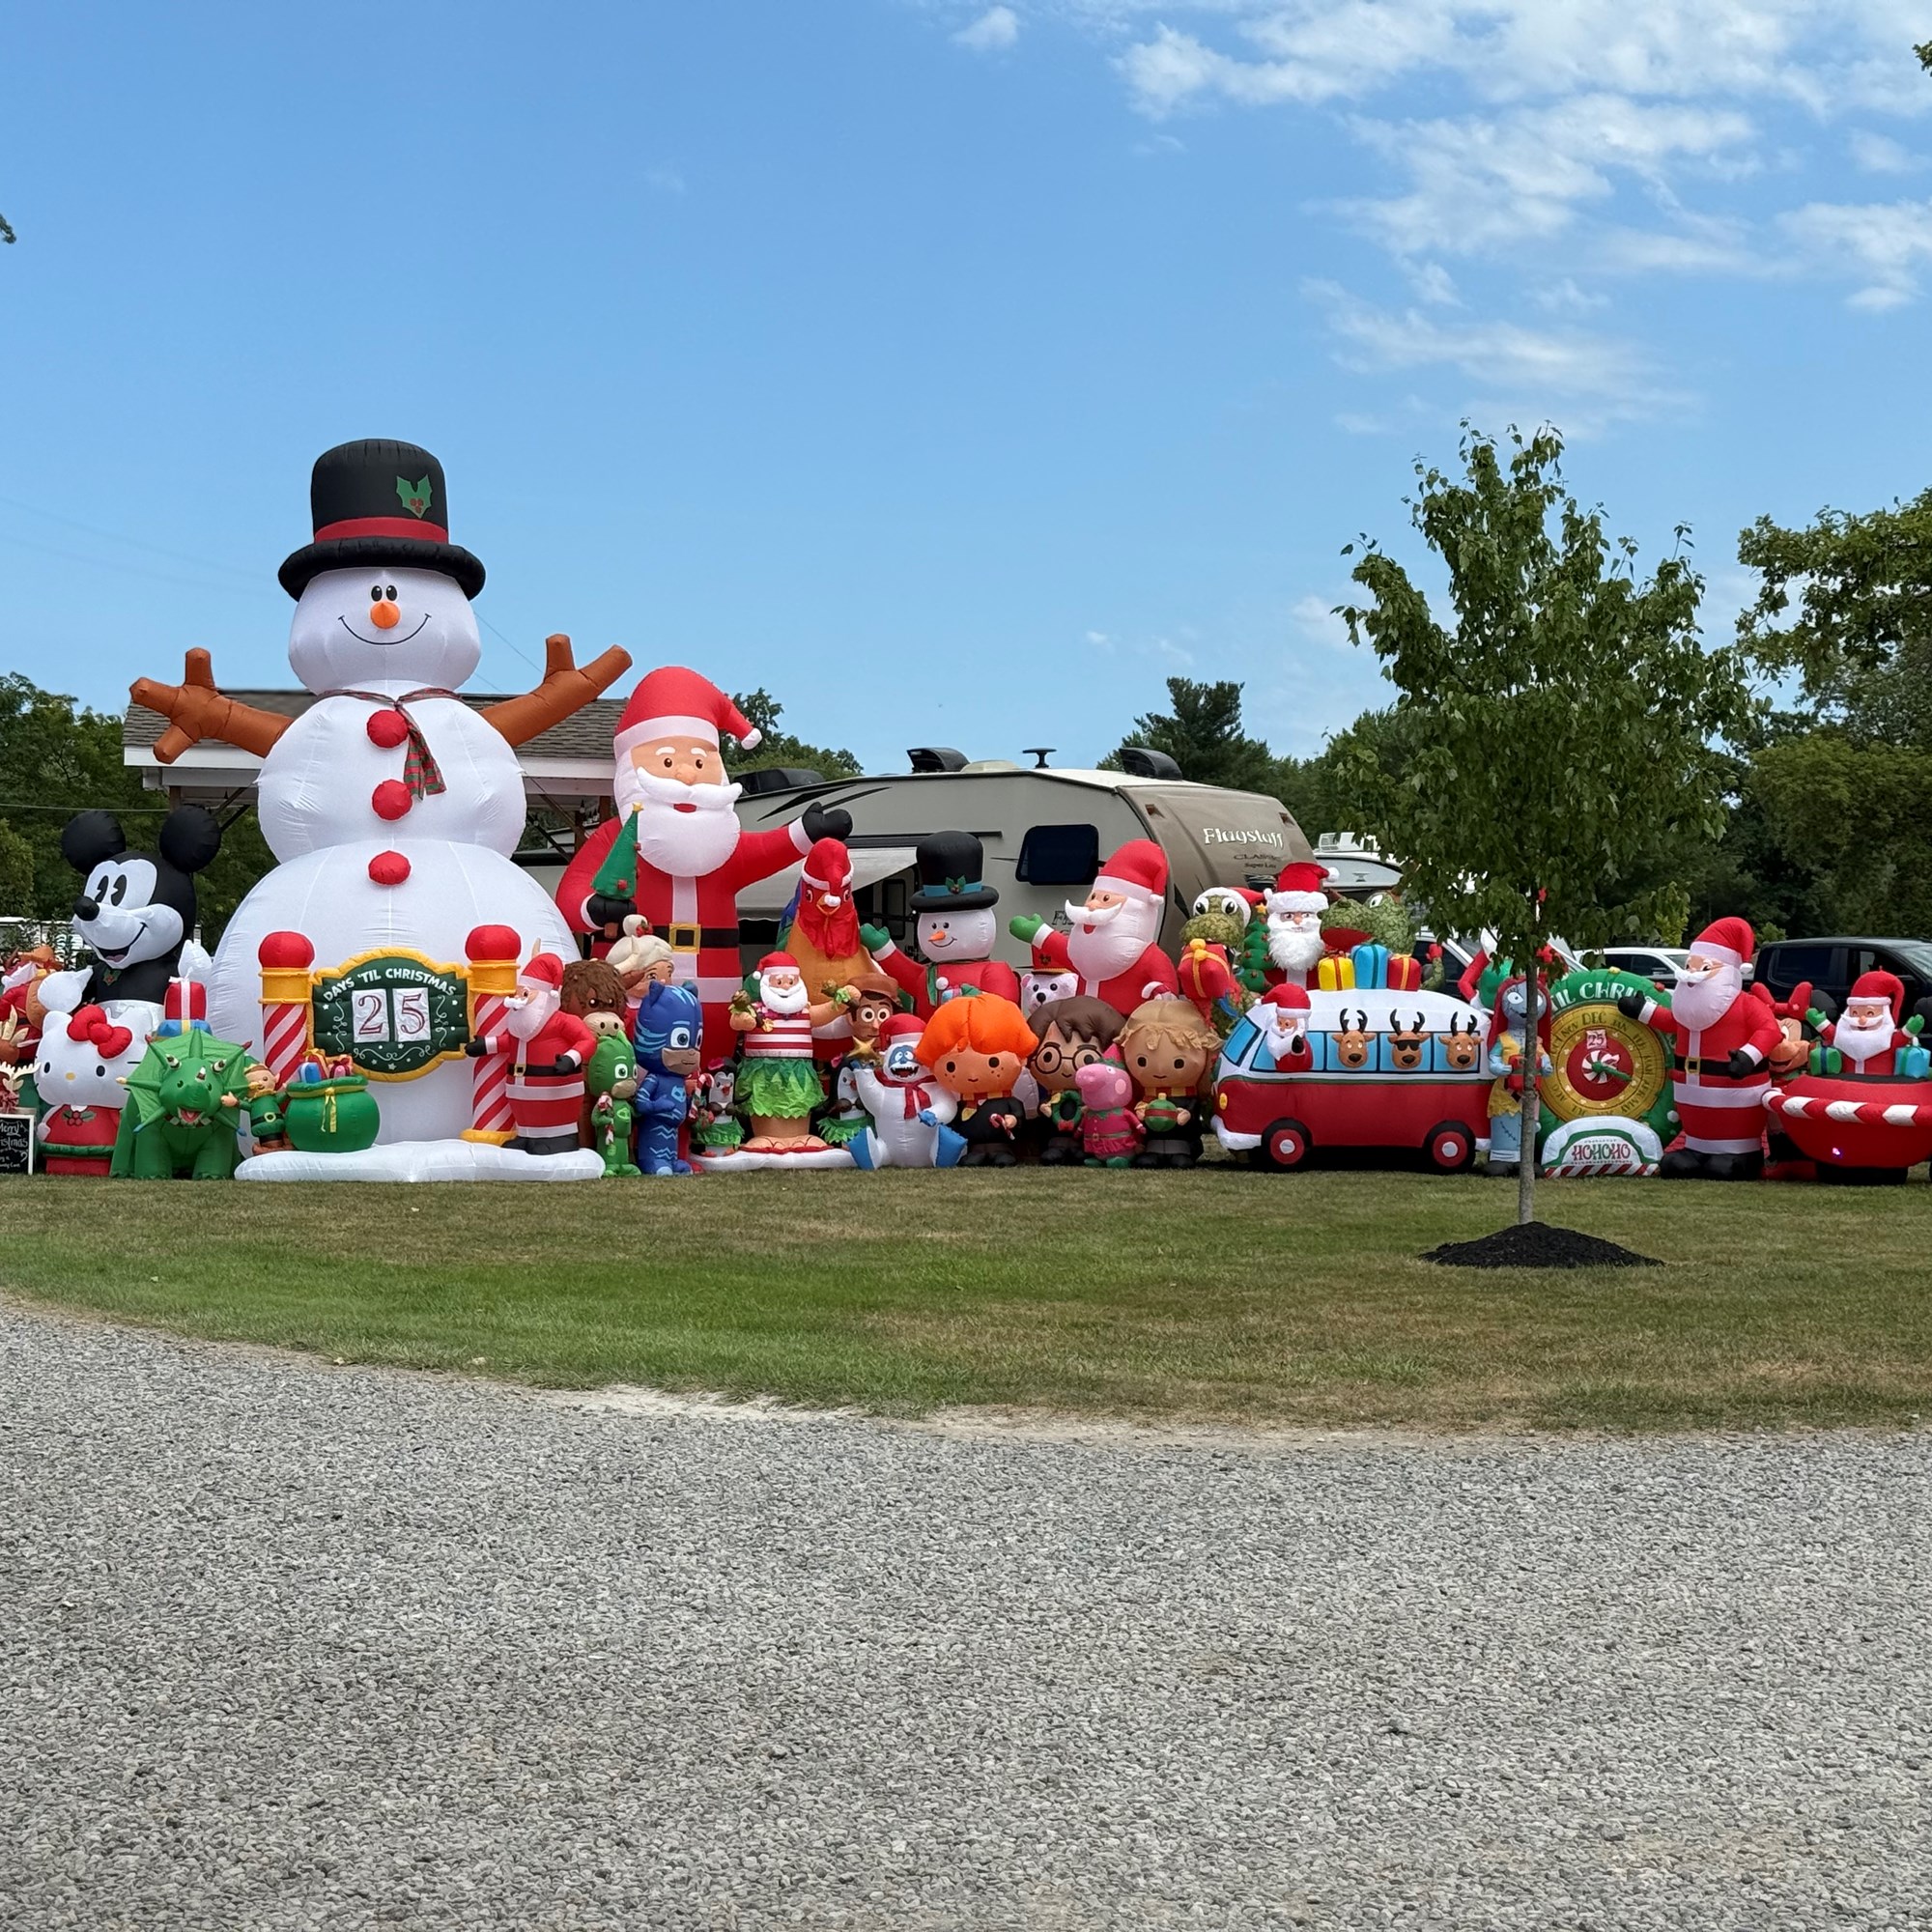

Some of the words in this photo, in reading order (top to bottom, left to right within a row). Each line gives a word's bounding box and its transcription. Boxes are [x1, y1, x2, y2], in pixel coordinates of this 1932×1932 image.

[1203, 828, 1283, 848] Flagstaff
[324, 978, 355, 1002] DAYS
[357, 969, 382, 983] 'TIL
[385, 968, 457, 996] CHRISTMAS
[1581, 1011, 1606, 1025] DEC
[1588, 1032, 1605, 1046] 25
[1572, 1144, 1631, 1161] HOHOHO
